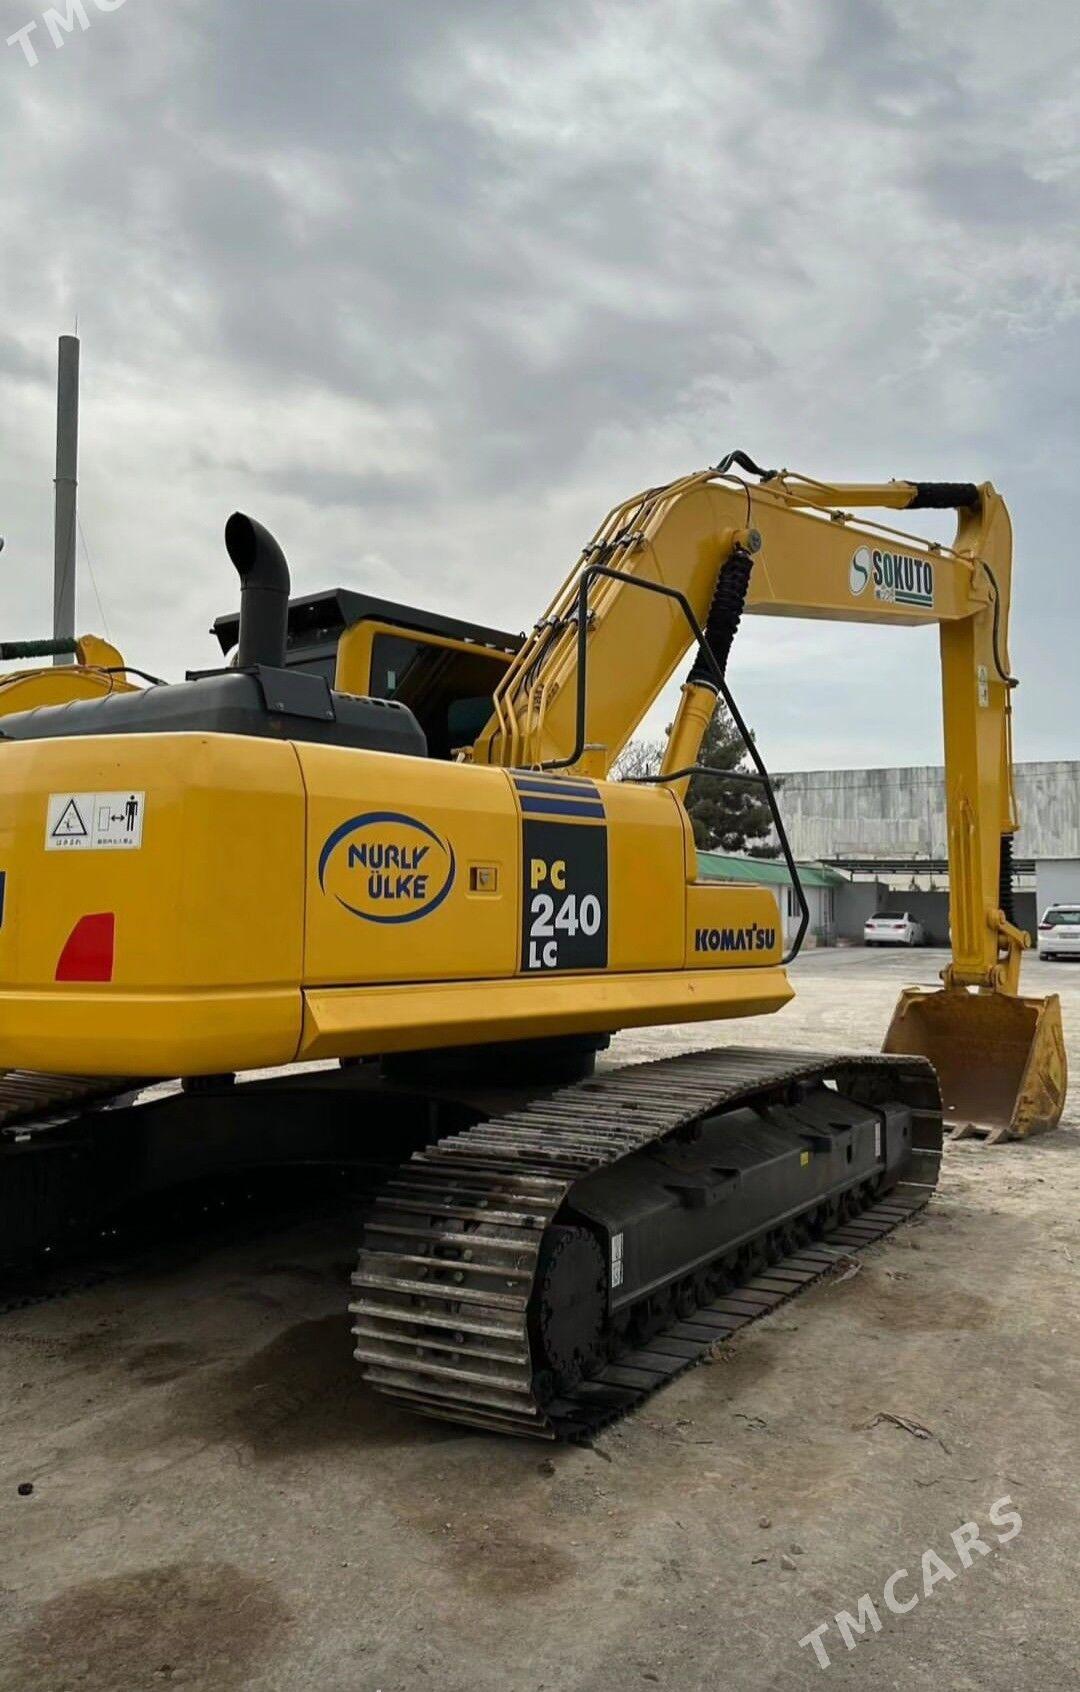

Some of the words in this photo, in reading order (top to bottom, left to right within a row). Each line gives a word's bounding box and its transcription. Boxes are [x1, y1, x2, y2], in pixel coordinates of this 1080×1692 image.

[872, 550, 933, 595] SOKUTO
[348, 843, 430, 869] NURLY
[368, 870, 429, 899] ÜLKE
[530, 859, 566, 891] PC
[530, 893, 601, 936] 240
[695, 923, 775, 952] KOMATSU
[529, 941, 558, 968] LC
